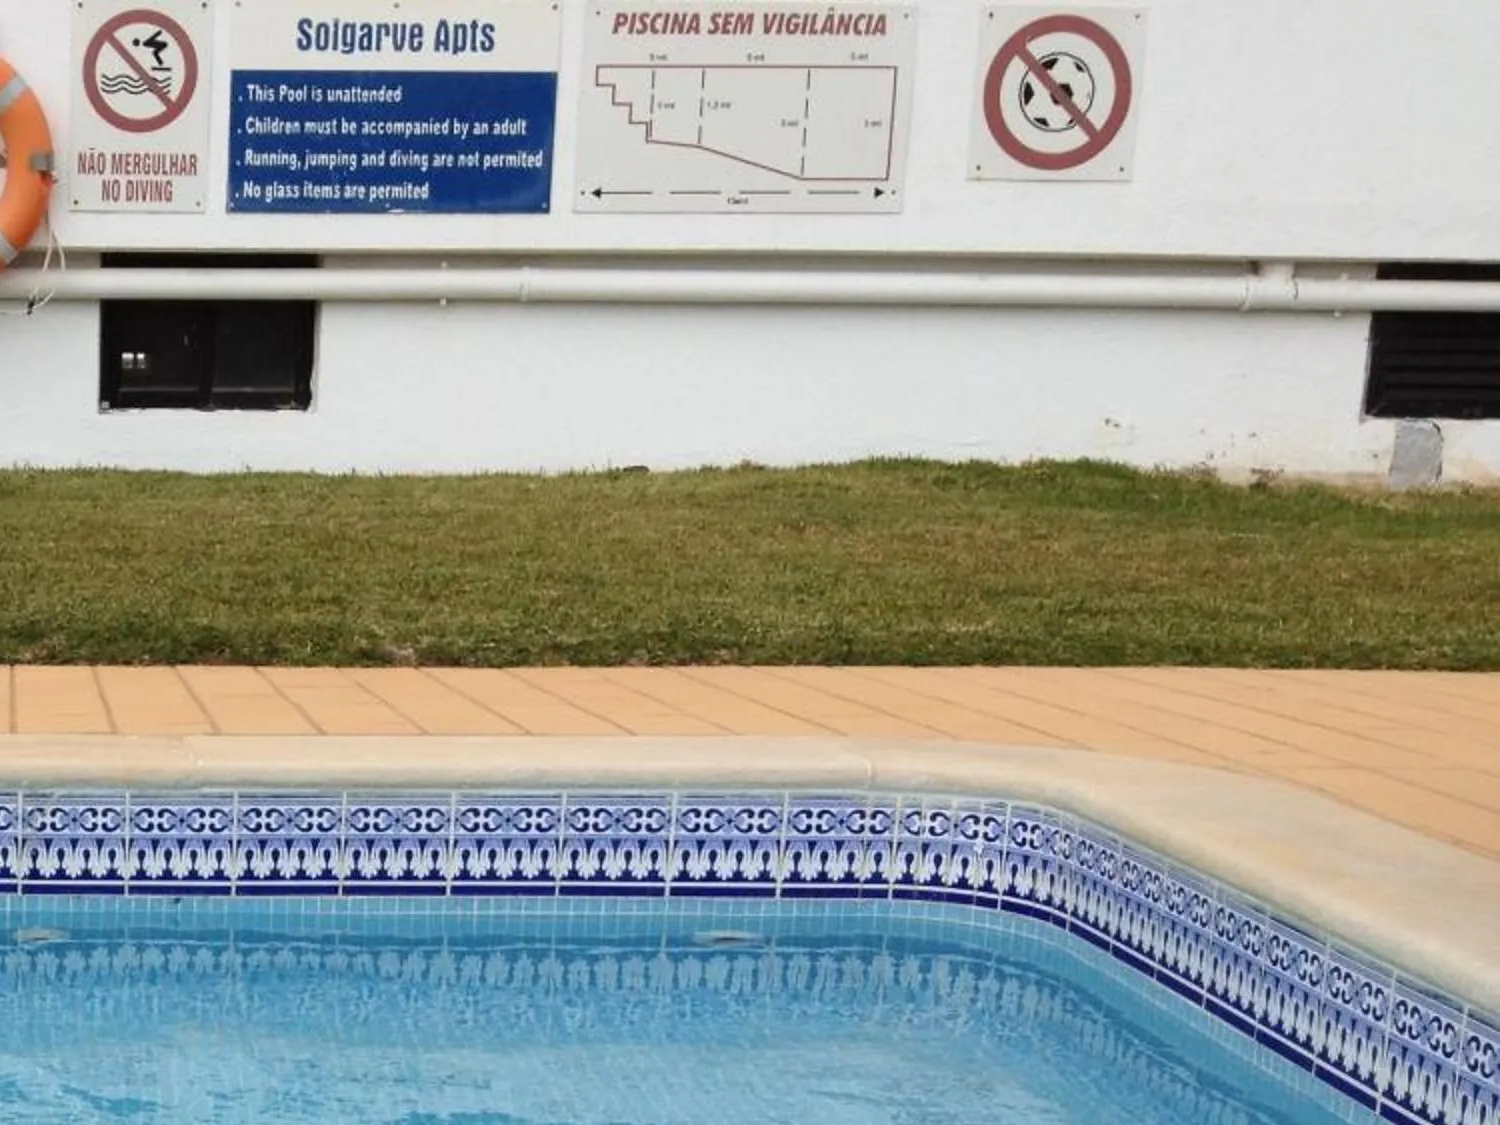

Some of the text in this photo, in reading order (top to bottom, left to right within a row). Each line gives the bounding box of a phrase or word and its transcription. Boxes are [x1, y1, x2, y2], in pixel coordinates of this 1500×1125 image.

[612, 7, 888, 36] PISCINA SEM VIGILÂNCIA
[296, 17, 496, 55] Solgarve Apts
[247, 84, 403, 103] This Pool is unattended
[245, 116, 527, 140] Children must be accompanied by an adult
[77, 146, 198, 176] NÃO MERGULHAR
[244, 149, 544, 172] Running, jumping and diving are not permited
[101, 180, 173, 203] NO DIVING
[243, 180, 430, 203] No glass items are permited
